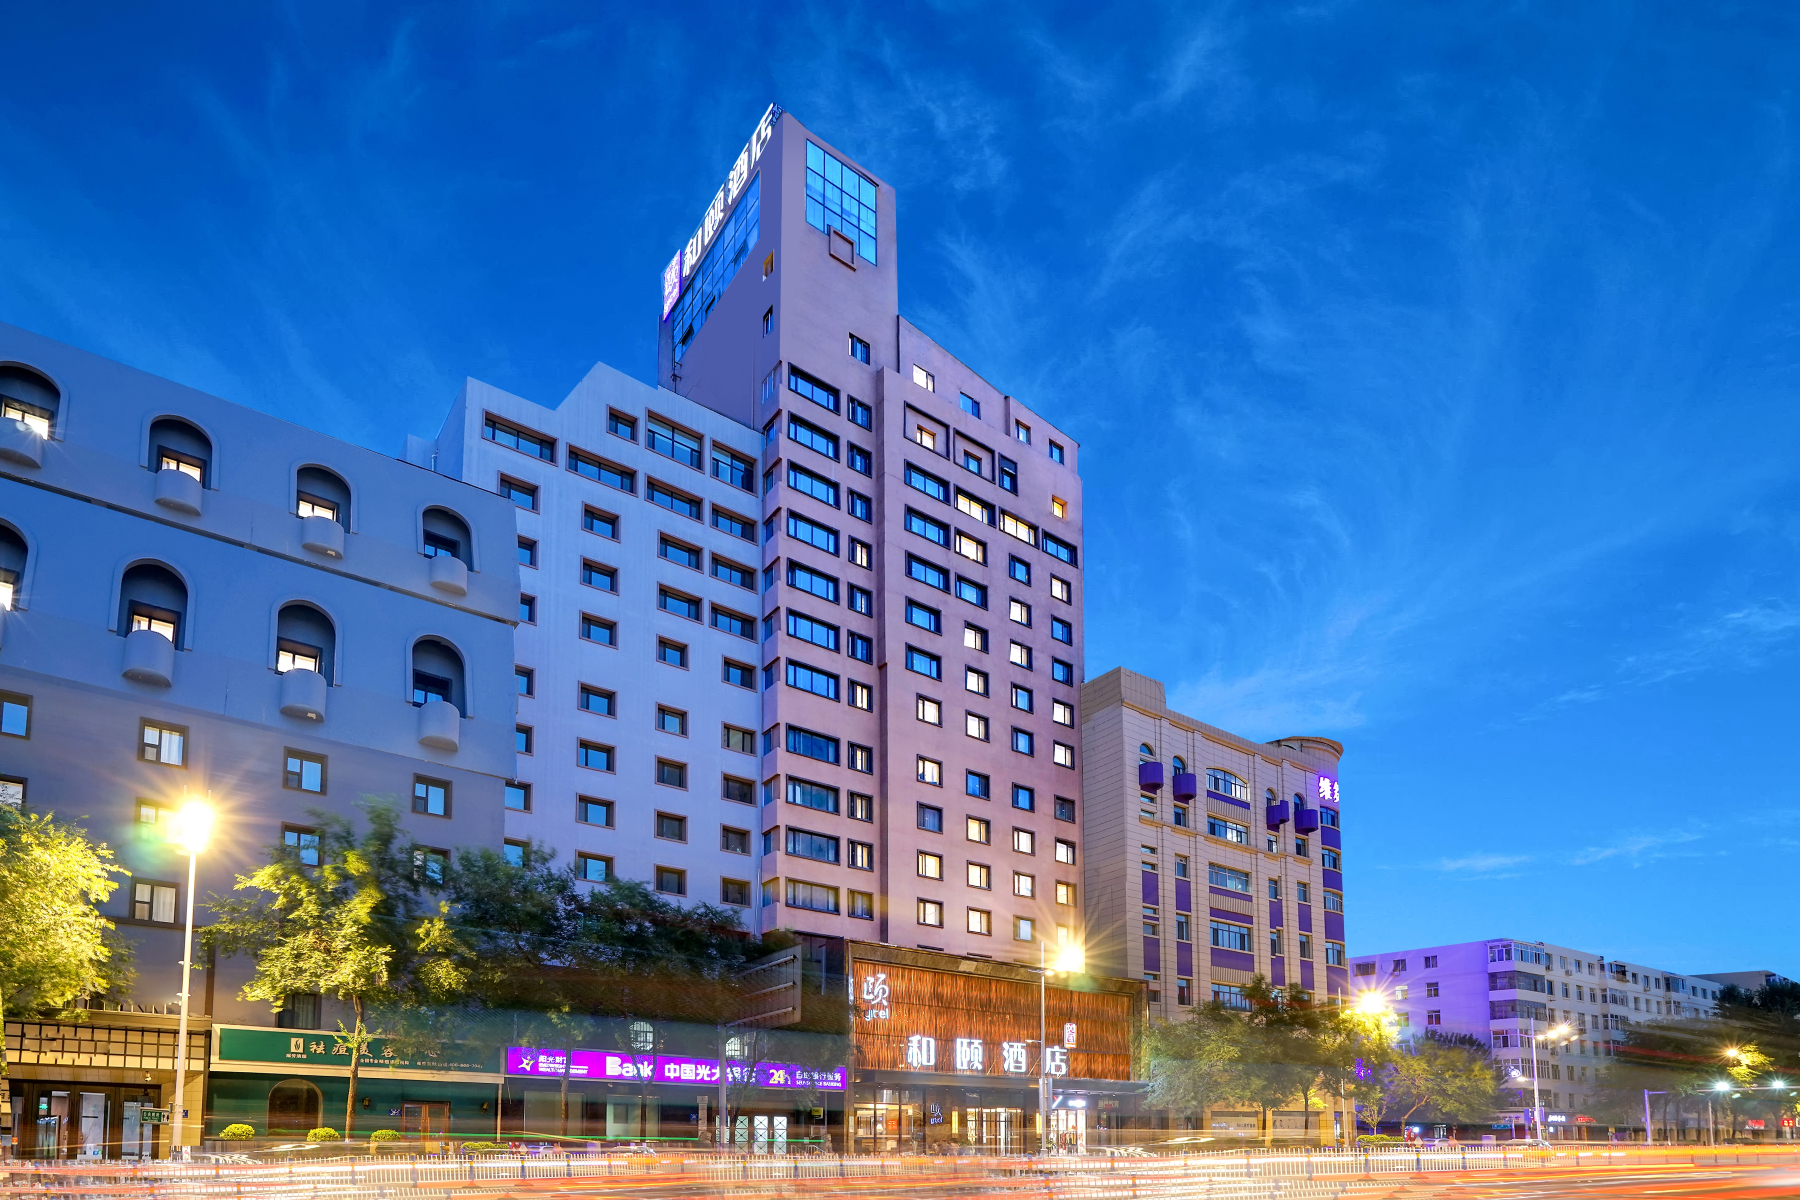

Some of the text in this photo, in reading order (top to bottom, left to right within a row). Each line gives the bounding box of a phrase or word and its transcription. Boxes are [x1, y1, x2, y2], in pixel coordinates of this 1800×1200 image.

[682, 102, 773, 278] 和颐酒店
[863, 973, 889, 1007] 颐
[864, 1007, 889, 1022] yitel
[907, 1034, 1068, 1076] 和颐酒店
